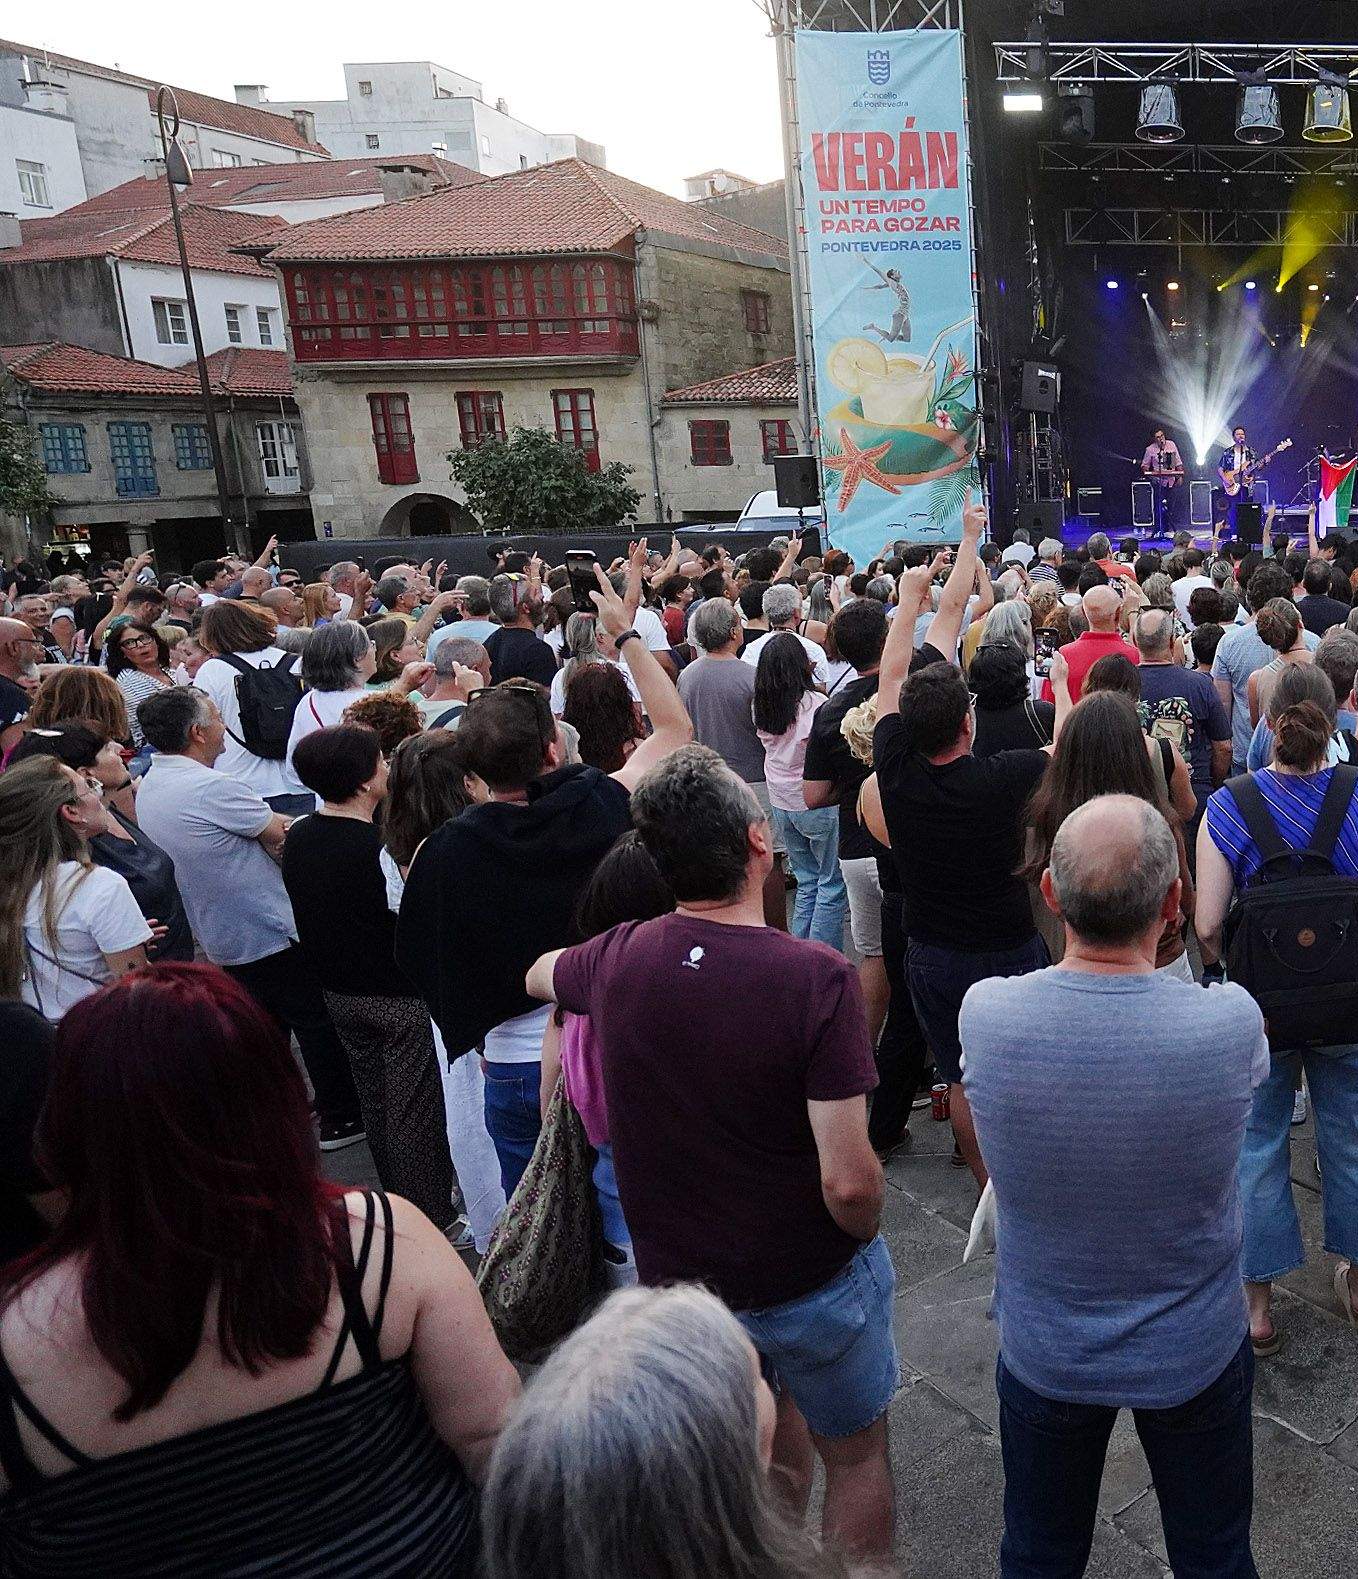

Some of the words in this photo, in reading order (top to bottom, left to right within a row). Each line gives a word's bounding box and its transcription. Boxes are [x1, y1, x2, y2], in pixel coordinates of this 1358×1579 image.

[863, 91, 898, 100] Concello
[864, 101, 909, 109] Pontevedra
[811, 116, 959, 191] VERÁN
[819, 199, 850, 215] UN
[851, 198, 926, 215] TEMPO
[821, 218, 881, 234] PARA
[883, 216, 960, 233] GOZAR
[821, 240, 922, 252] PONTEVEDRA
[923, 240, 962, 251] 2025
